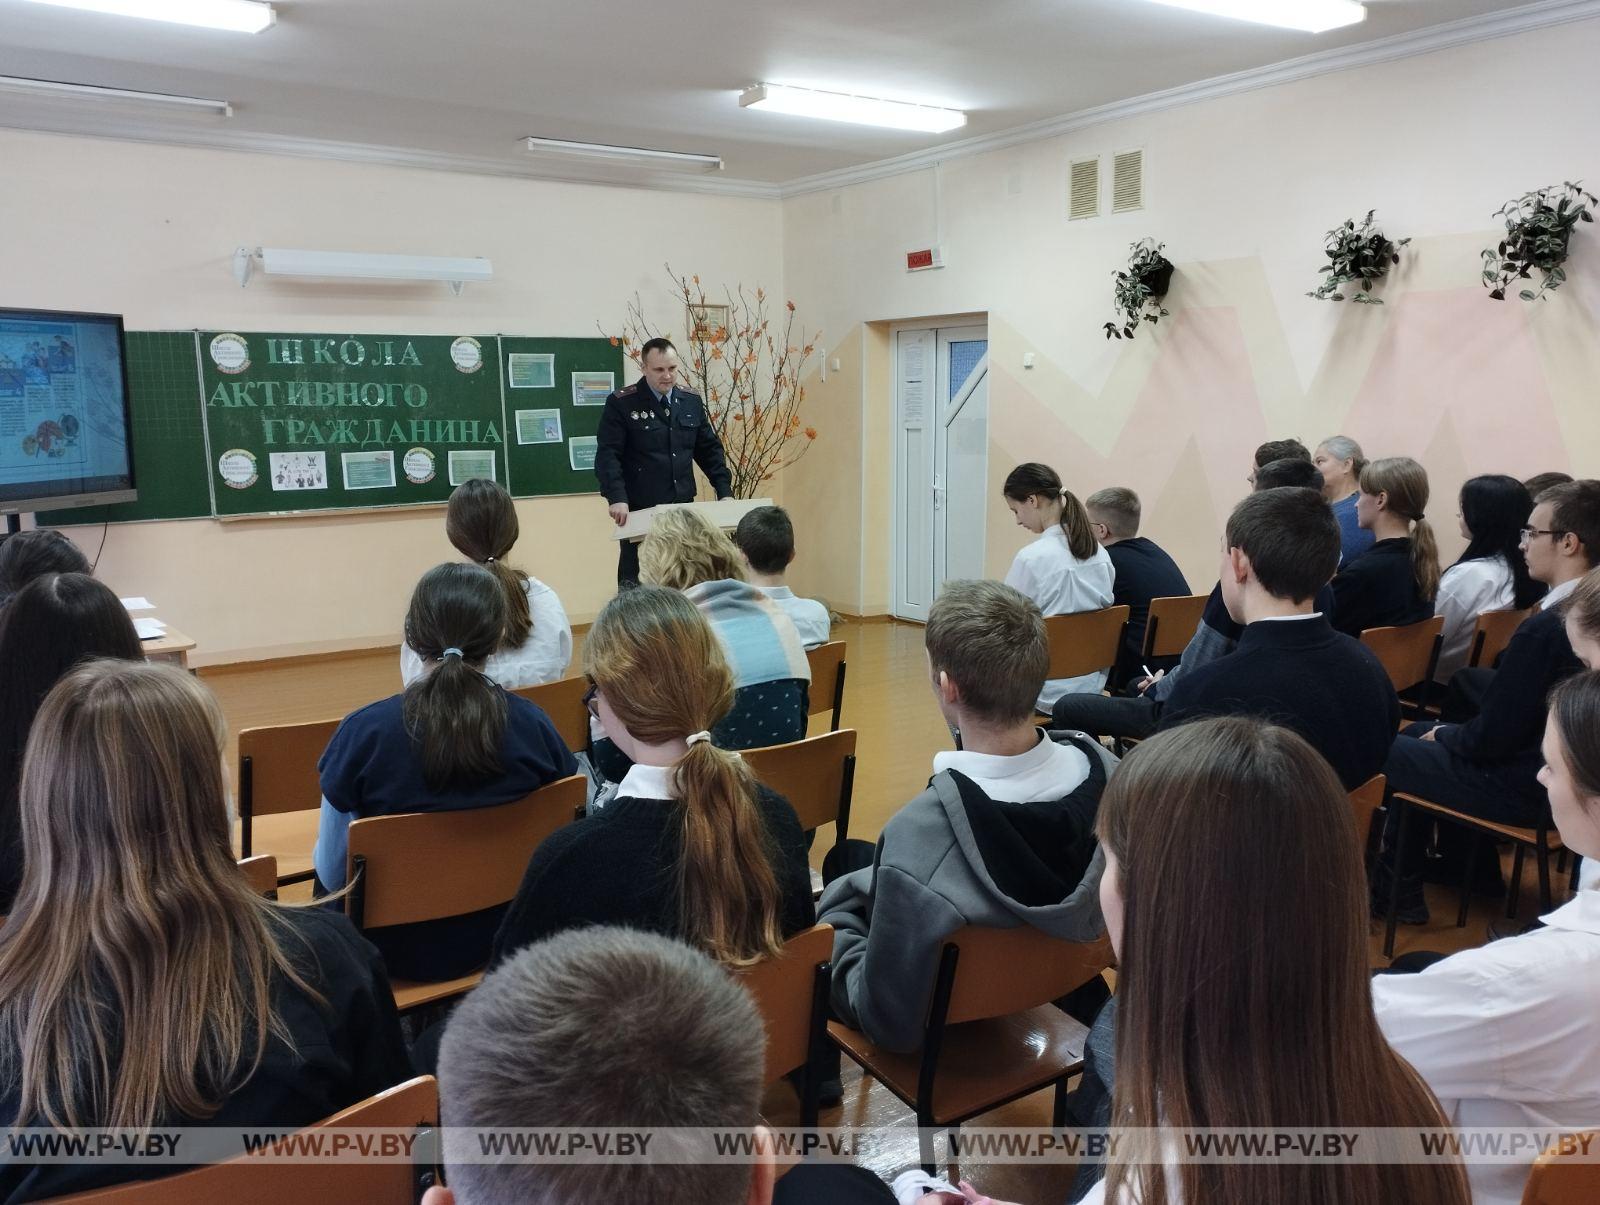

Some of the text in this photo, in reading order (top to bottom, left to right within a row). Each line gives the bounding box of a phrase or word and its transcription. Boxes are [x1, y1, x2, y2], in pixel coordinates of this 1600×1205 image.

[265, 337, 424, 367] ШКОЛА
[207, 380, 428, 408] АКТИВНОГО
[263, 419, 504, 448] ГРАЖДАНИНА
